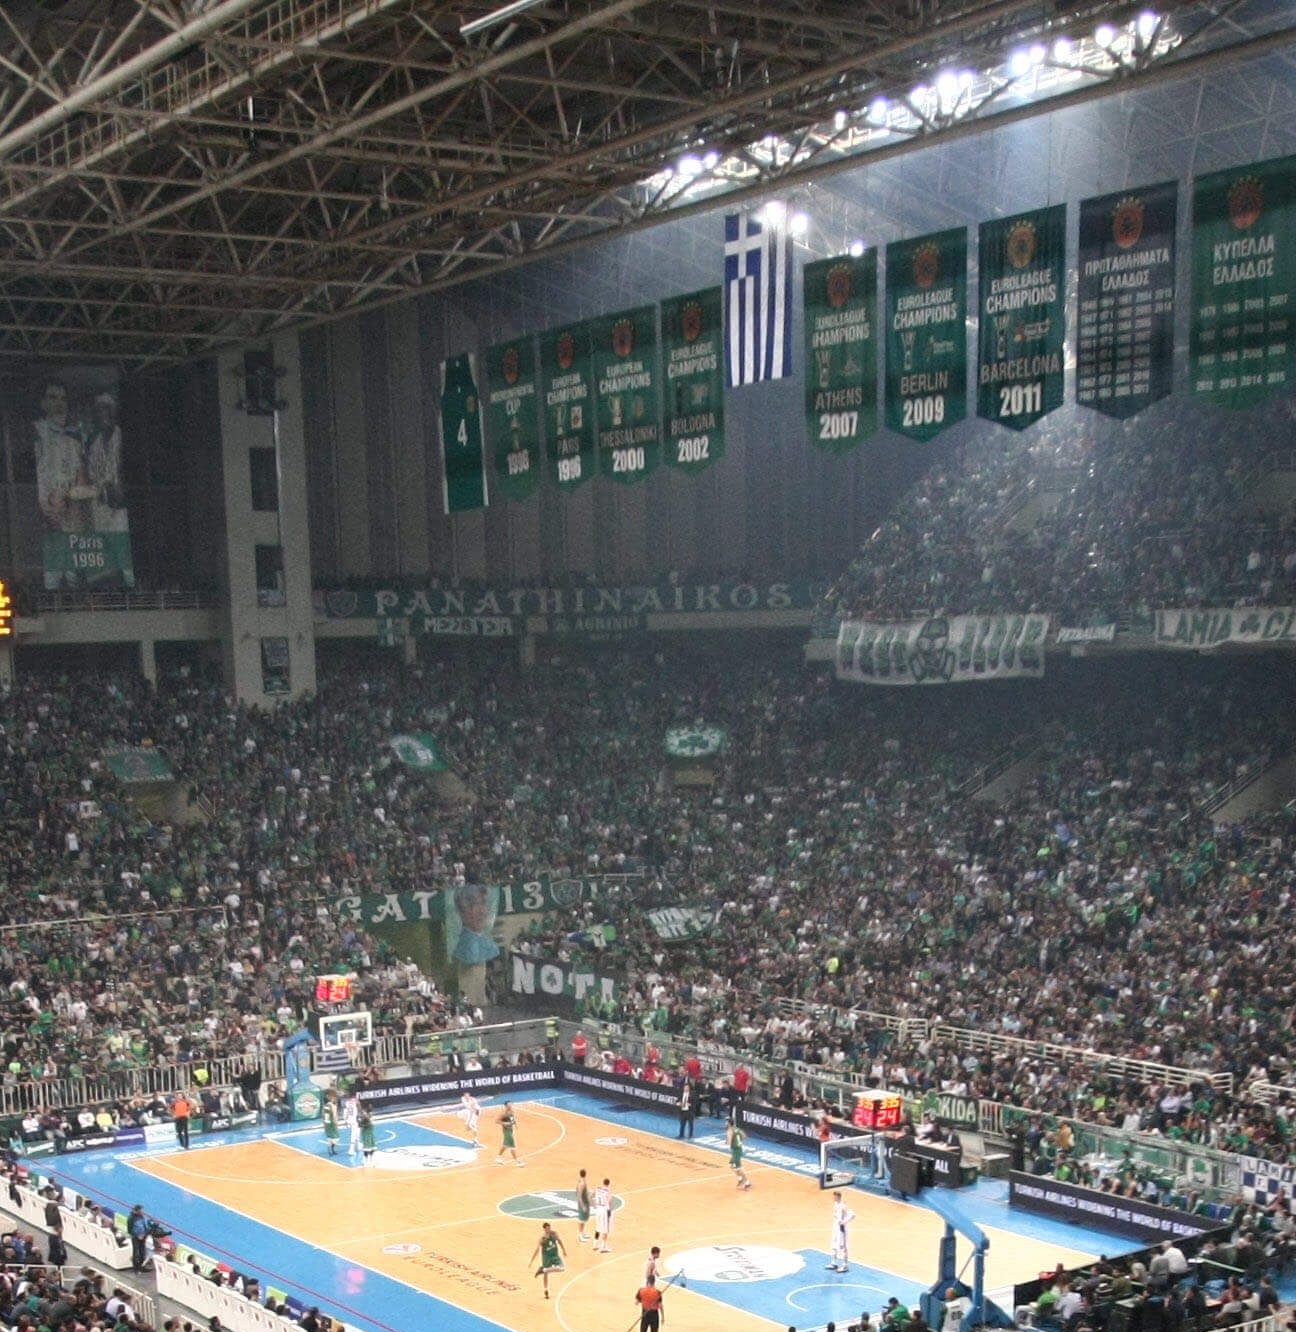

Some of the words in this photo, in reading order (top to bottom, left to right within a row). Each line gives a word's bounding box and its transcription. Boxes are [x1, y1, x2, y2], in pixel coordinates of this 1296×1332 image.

[1214, 235, 1274, 262] ΚΥΠΕΛΛΑ
[991, 269, 1052, 294] EUROLEAGUE
[1102, 271, 1150, 292] ΕΛΛΑΔΟΣ
[1213, 258, 1274, 286] ΕΛΛΑΔΟΣ
[897, 288, 953, 310] EUROLEAGUE
[986, 284, 1056, 313] CHAMPIONS
[893, 304, 957, 329] CHAMPIONS
[667, 354, 717, 378] CHAMPIONS
[981, 353, 1059, 384] BARCELONA
[599, 372, 651, 394] CHAMPIONS
[900, 371, 948, 395] BERLIN
[815, 387, 862, 410] ATHENS
[903, 395, 945, 427] 2009
[1000, 383, 1041, 416] 2011
[457, 419, 468, 447] 4
[671, 413, 715, 434] BOLOGNA
[820, 411, 859, 440] 2007
[613, 447, 645, 472] 2000
[678, 435, 709, 462] 2002
[70, 535, 103, 548] Paris
[73, 553, 104, 567] 1996
[375, 582, 792, 616] PANATHINAIKOS
[1158, 610, 1232, 646] LAMIA
[502, 881, 545, 913] 13
[388, 1085, 420, 1097] AIRLINES
[422, 1080, 459, 1093] WIDENING
[460, 1079, 473, 1089] THE
[475, 1076, 501, 1087] WORLD
[502, 1075, 511, 1084] OF
[513, 1070, 555, 1083] BASKETBALL
[658, 1094, 678, 1105] BASKET
[742, 1110, 772, 1128] TURKISH
[772, 1117, 804, 1135] AIRLINES
[854, 1109, 873, 1126] 24
[877, 1109, 897, 1127] 24
[934, 1159, 950, 1173] ALL
[1045, 1191, 1077, 1208] AIRLINES
[1116, 1209, 1131, 1222] THE
[1132, 1212, 1160, 1228] WORLD
[1161, 1220, 1171, 1232] OF
[1173, 1223, 1206, 1237] BASKET
